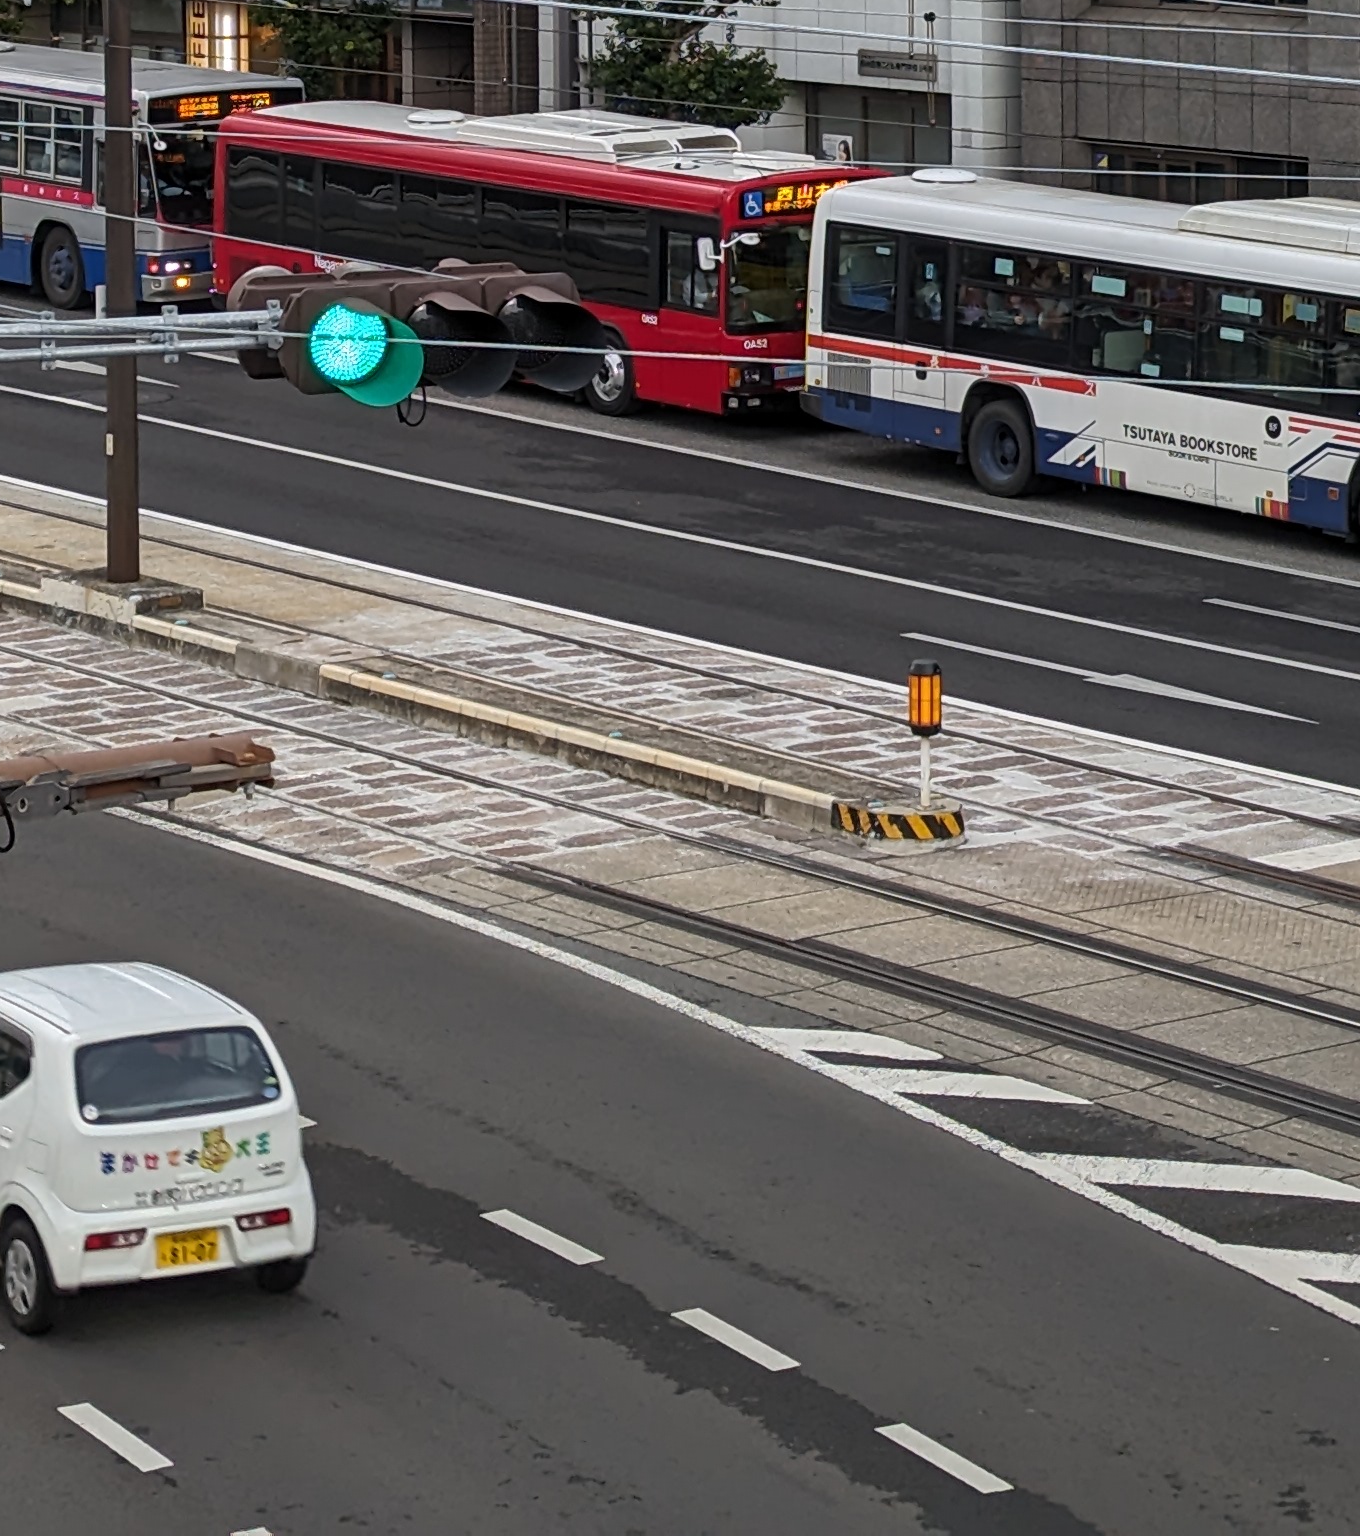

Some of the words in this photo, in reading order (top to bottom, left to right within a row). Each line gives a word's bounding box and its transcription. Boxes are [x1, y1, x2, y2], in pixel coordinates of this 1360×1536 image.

[776, 179, 849, 202] 西山木
[1122, 423, 1176, 447] TSUTAYA
[1179, 433, 1258, 462] BOOKSTORE
